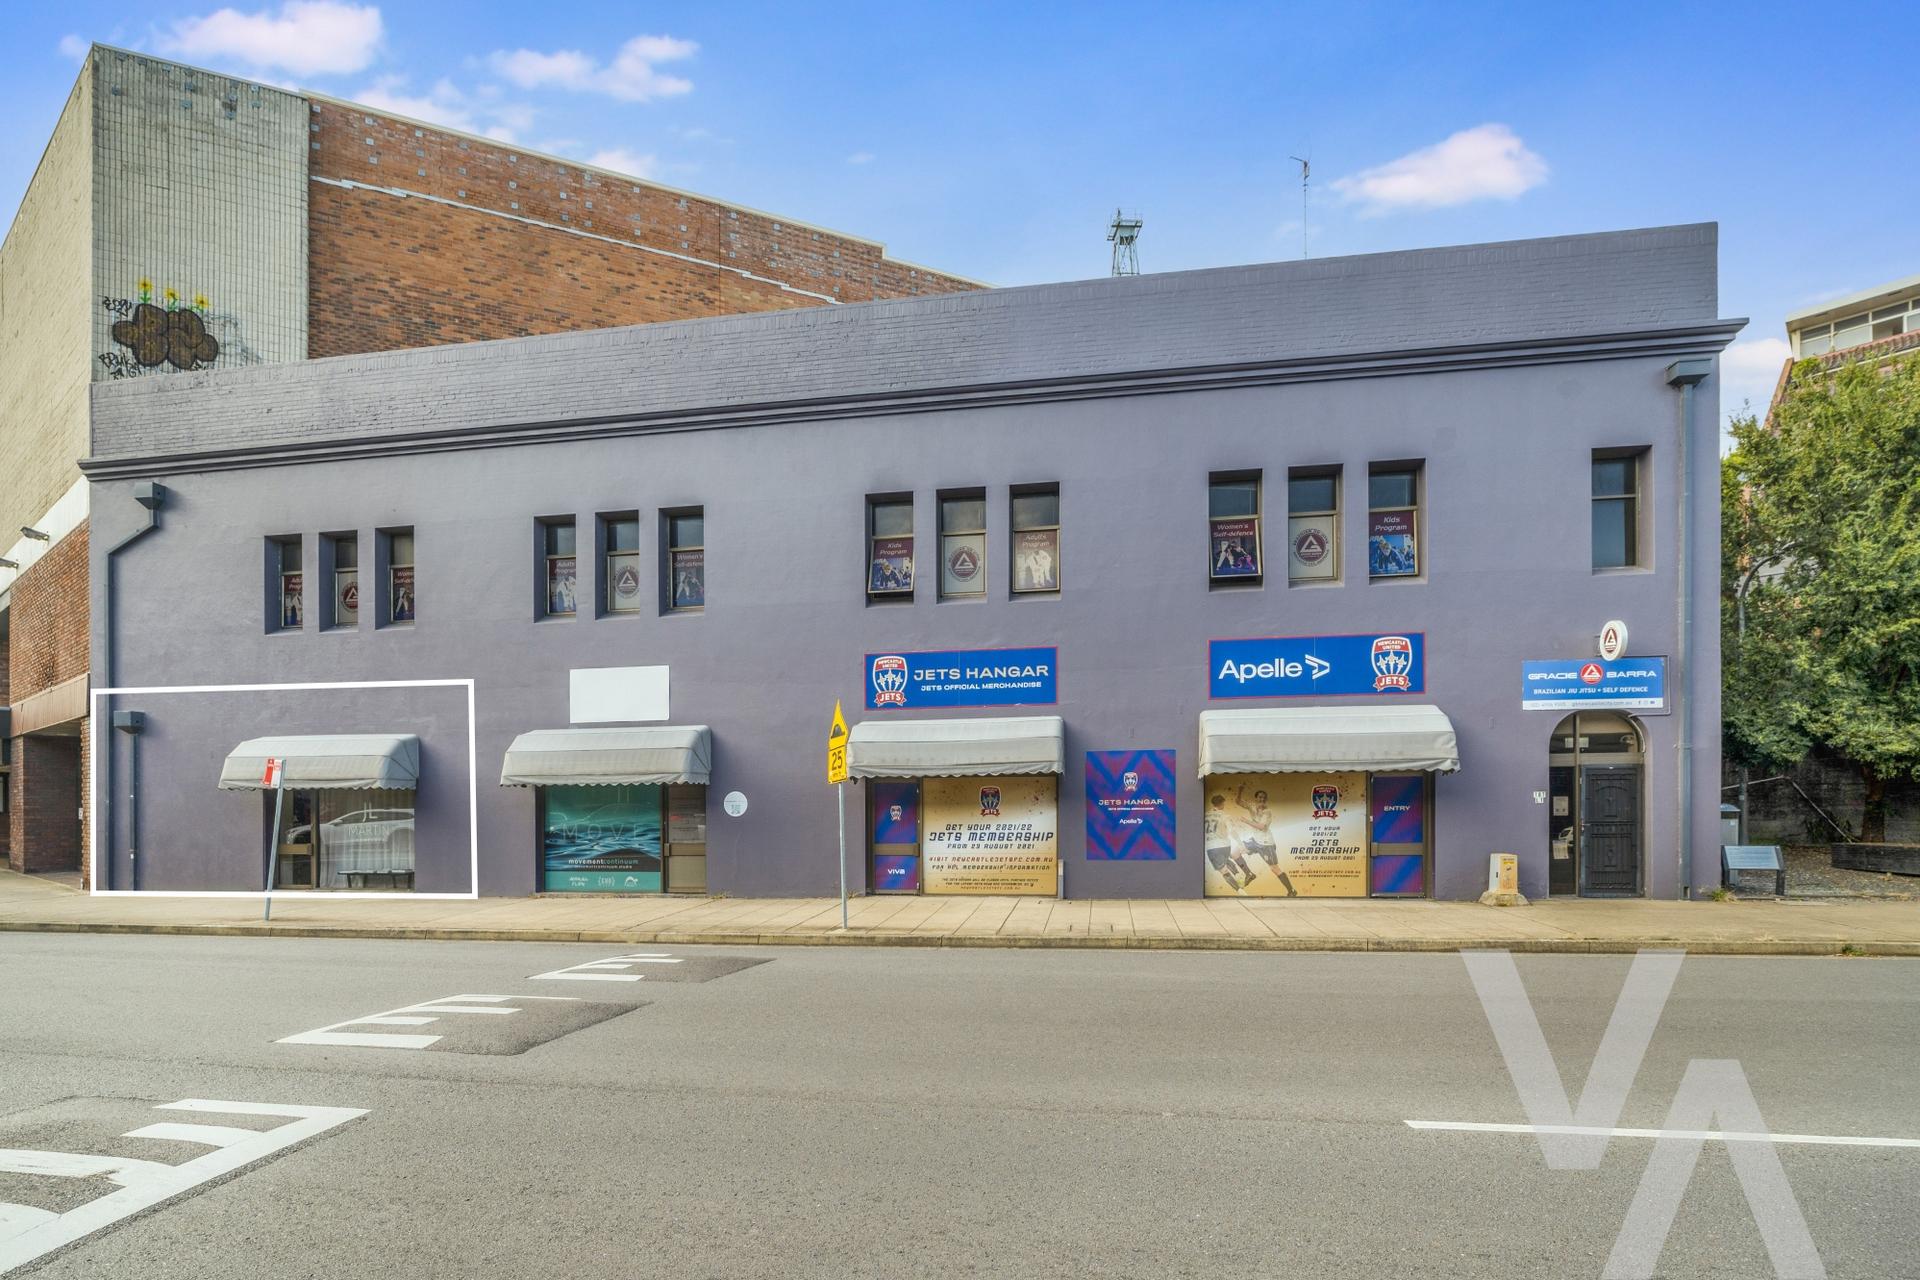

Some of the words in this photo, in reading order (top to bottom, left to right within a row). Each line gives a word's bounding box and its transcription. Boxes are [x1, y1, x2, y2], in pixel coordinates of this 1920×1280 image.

[914, 669, 960, 680] JETS
[966, 665, 1048, 679] HANGAR
[1218, 658, 1302, 683] Apelle
[1528, 672, 1577, 680] GRACIE
[1607, 670, 1657, 678] BARRA
[1380, 677, 1404, 686] JETS
[880, 693, 900, 701] JETS
[832, 750, 842, 770] 25
[363, 801, 378, 822] JL
[929, 832, 962, 841] JETS
[968, 832, 1053, 841] MEMBERSHIP
